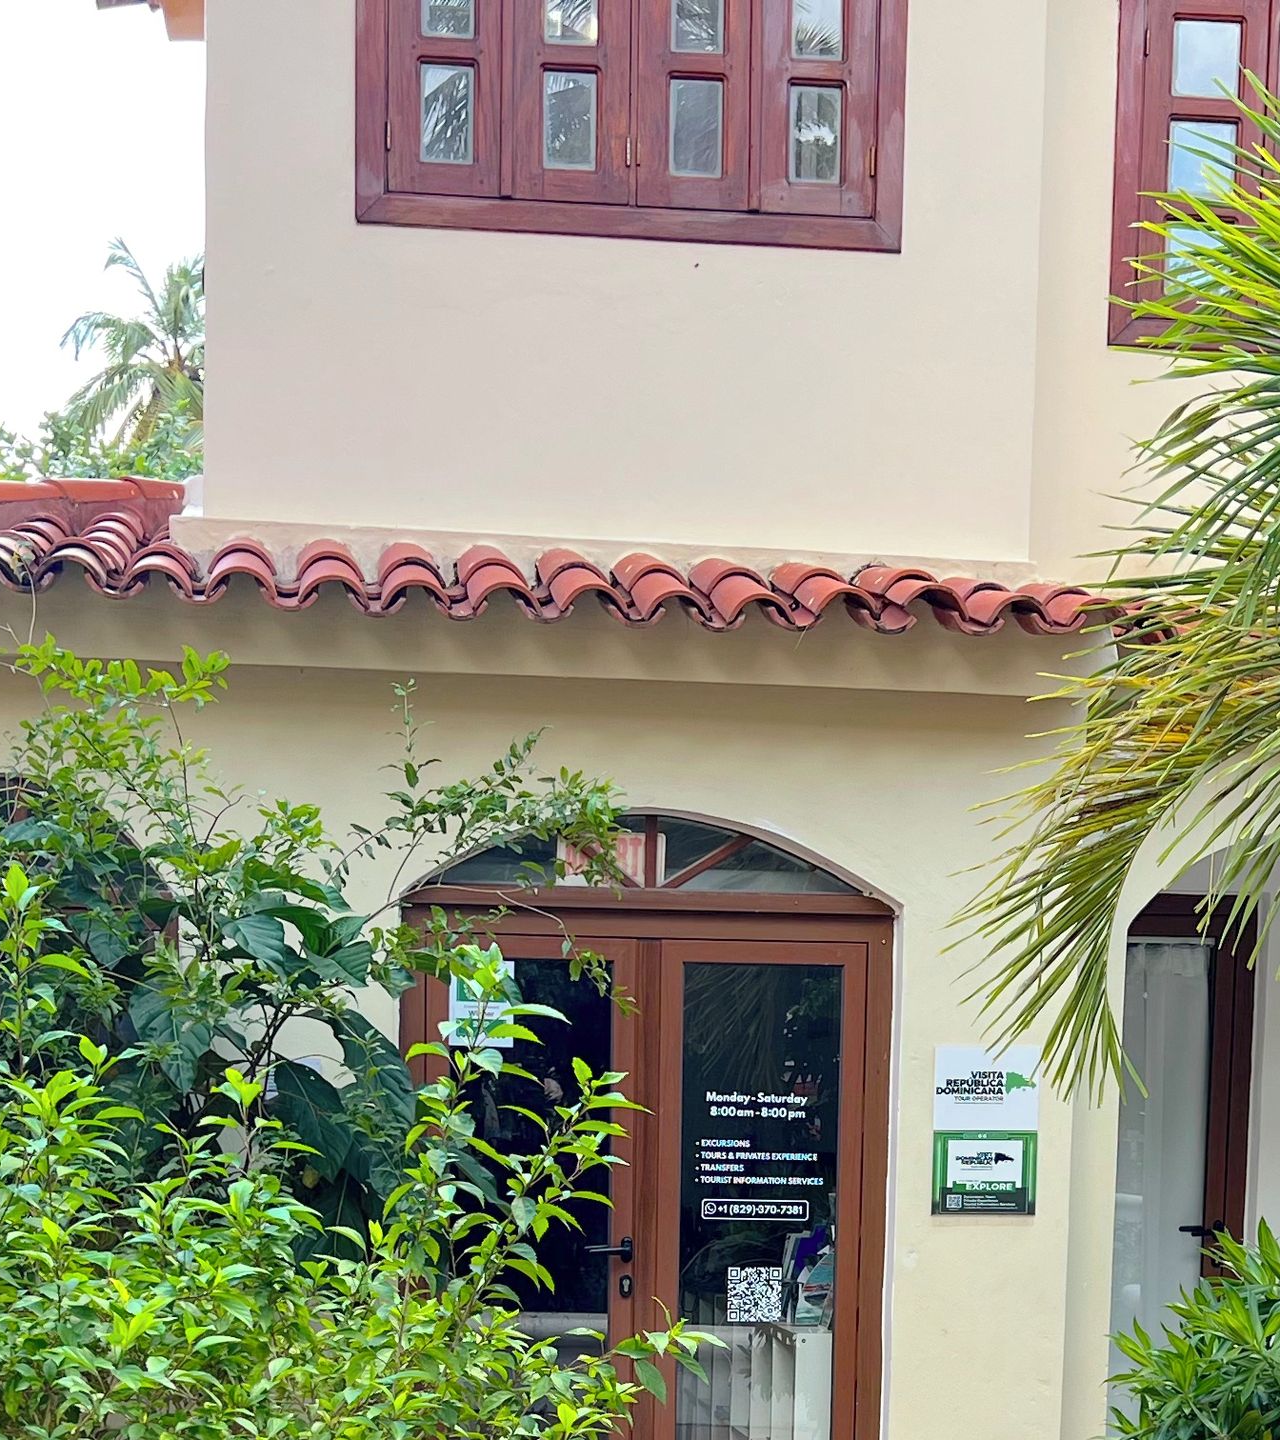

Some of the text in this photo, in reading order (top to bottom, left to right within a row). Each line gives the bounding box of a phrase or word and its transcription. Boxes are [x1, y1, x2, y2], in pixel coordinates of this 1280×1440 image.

[971, 1071, 1004, 1079] VISITA
[936, 1087, 1004, 1095] DOMINICANA
[706, 1091, 751, 1105] Monday
[756, 1092, 808, 1106] Saturday
[701, 1139, 750, 1148] EXCURSIONS
[701, 1151, 726, 1160] TOURS
[728, 1152, 735, 1160] &
[736, 1152, 770, 1161] PRIVATES
[701, 1163, 744, 1172] TRANSFERS
[700, 1175, 824, 1186] TOURIST INFORMATION SERVICES
[966, 1183, 1013, 1191] EXPLORE
[718, 1204, 727, 1214] +1
